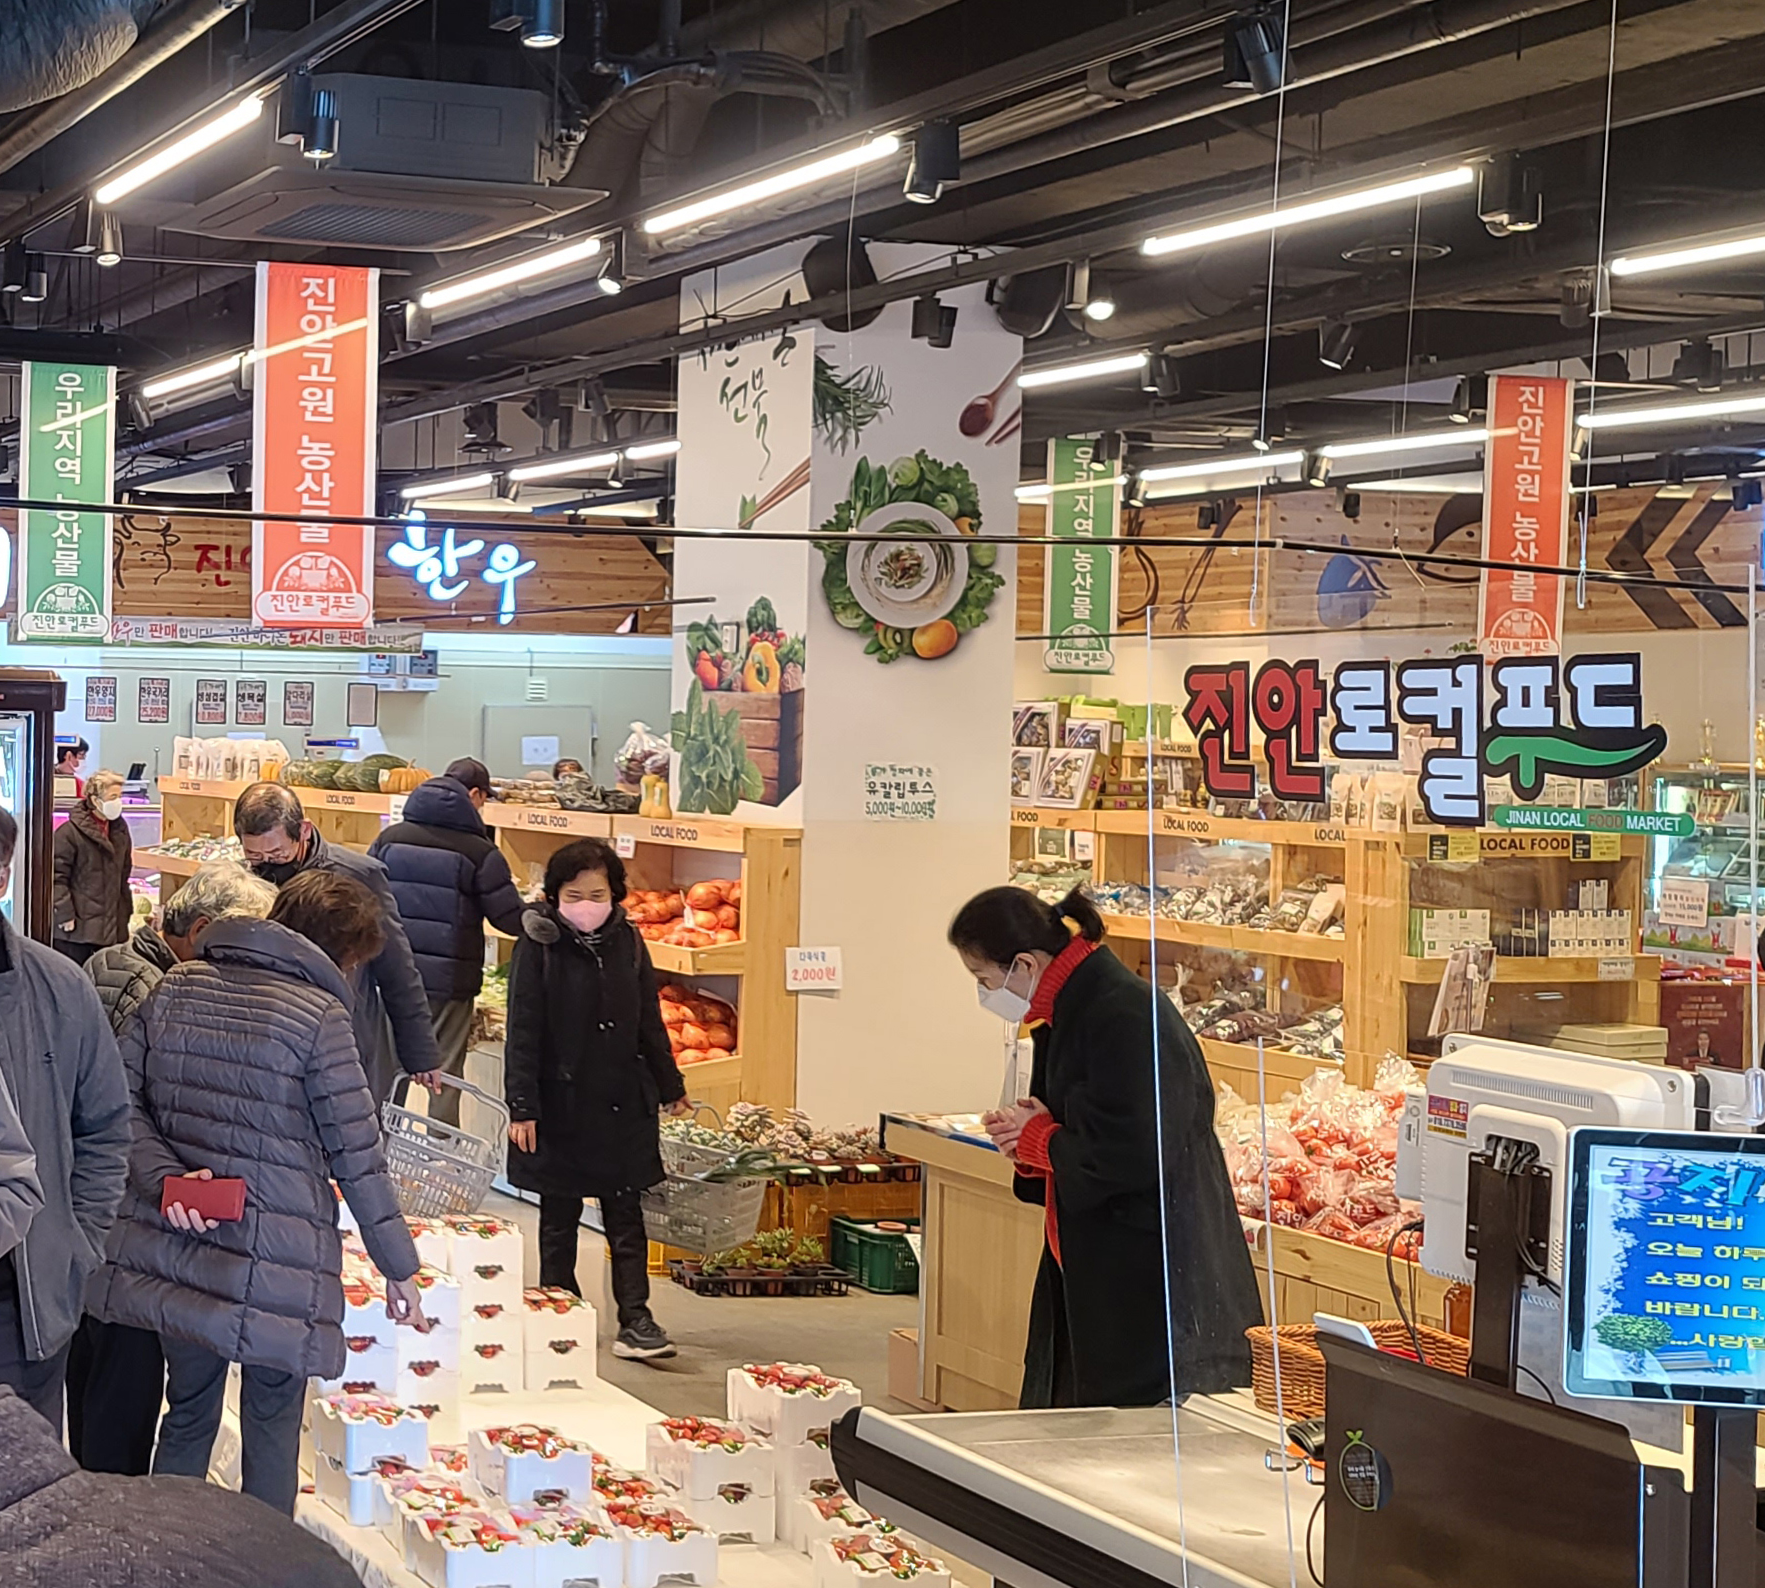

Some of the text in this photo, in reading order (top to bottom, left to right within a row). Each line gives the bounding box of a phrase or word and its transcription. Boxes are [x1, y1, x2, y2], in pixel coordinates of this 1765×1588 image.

[294, 276, 338, 544] 진안고원 농산물
[51, 372, 85, 577] 우리지역 농산물
[1509, 385, 1545, 602] 진안고원 농산물
[1070, 446, 1094, 619] 우리지역 농산물
[386, 510, 537, 625] 한우
[269, 592, 357, 617] 진안로컬푸드
[32, 614, 99, 633] 진안로컬푸드
[1053, 650, 1106, 666] 진안로컬푸드
[1182, 652, 1668, 826] 진안로컬푸드
[866, 780, 935, 799] 유칼립투스
[527, 813, 548, 826] LOCAL
[1163, 818, 1210, 833] LOCAL FOOD
[1505, 808, 1682, 832] JINAN LOCAL FOOD MARKET
[650, 824, 698, 841] LOCAL FOOD
[1314, 827, 1346, 841] LOCAL
[1479, 837, 1526, 851] LOCAL
[1529, 837, 1570, 850] FOOD
[791, 966, 836, 982] 2,000원
[1647, 1212, 1745, 1230] 고객님!
[1646, 1241, 1703, 1259] 오늘
[1645, 1271, 1731, 1290] 쇼핑이
